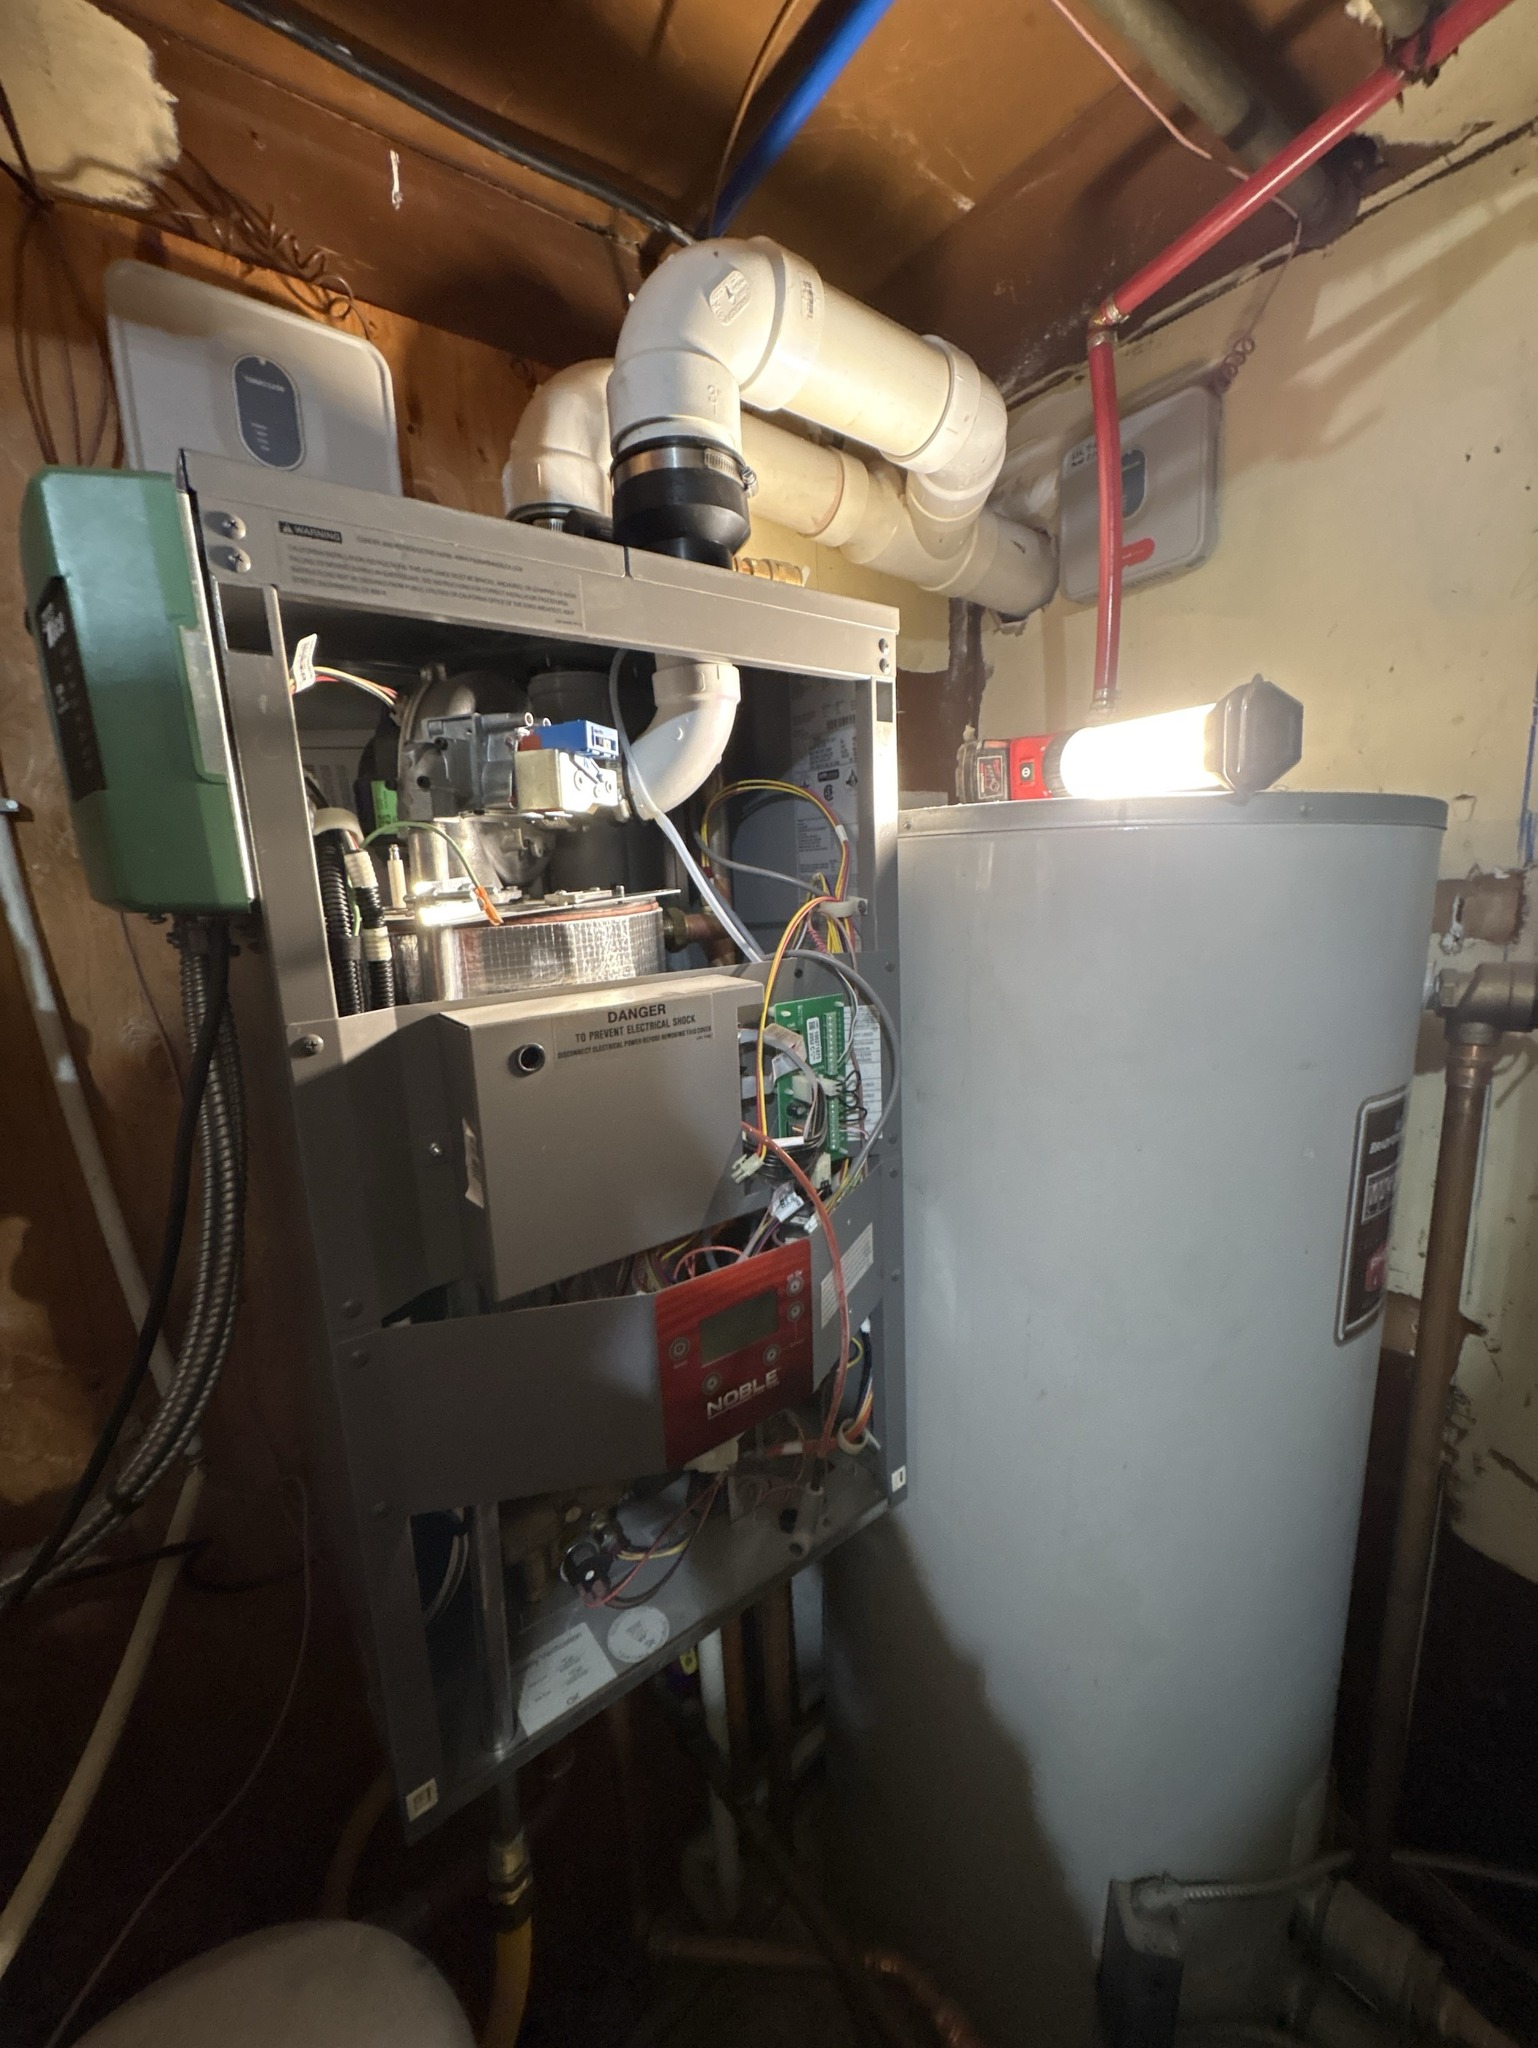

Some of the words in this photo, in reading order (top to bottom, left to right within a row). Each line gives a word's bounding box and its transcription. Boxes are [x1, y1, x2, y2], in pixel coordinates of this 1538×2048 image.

[294, 526, 341, 541] WARNING
[608, 1004, 666, 1023] DANGER
[575, 1033, 587, 1043] TO
[589, 1026, 625, 1041] PREVENT
[627, 1019, 670, 1034] ELECTRICAL
[673, 1014, 696, 1026] SHOCK
[706, 1369, 779, 1416] NOBLE
